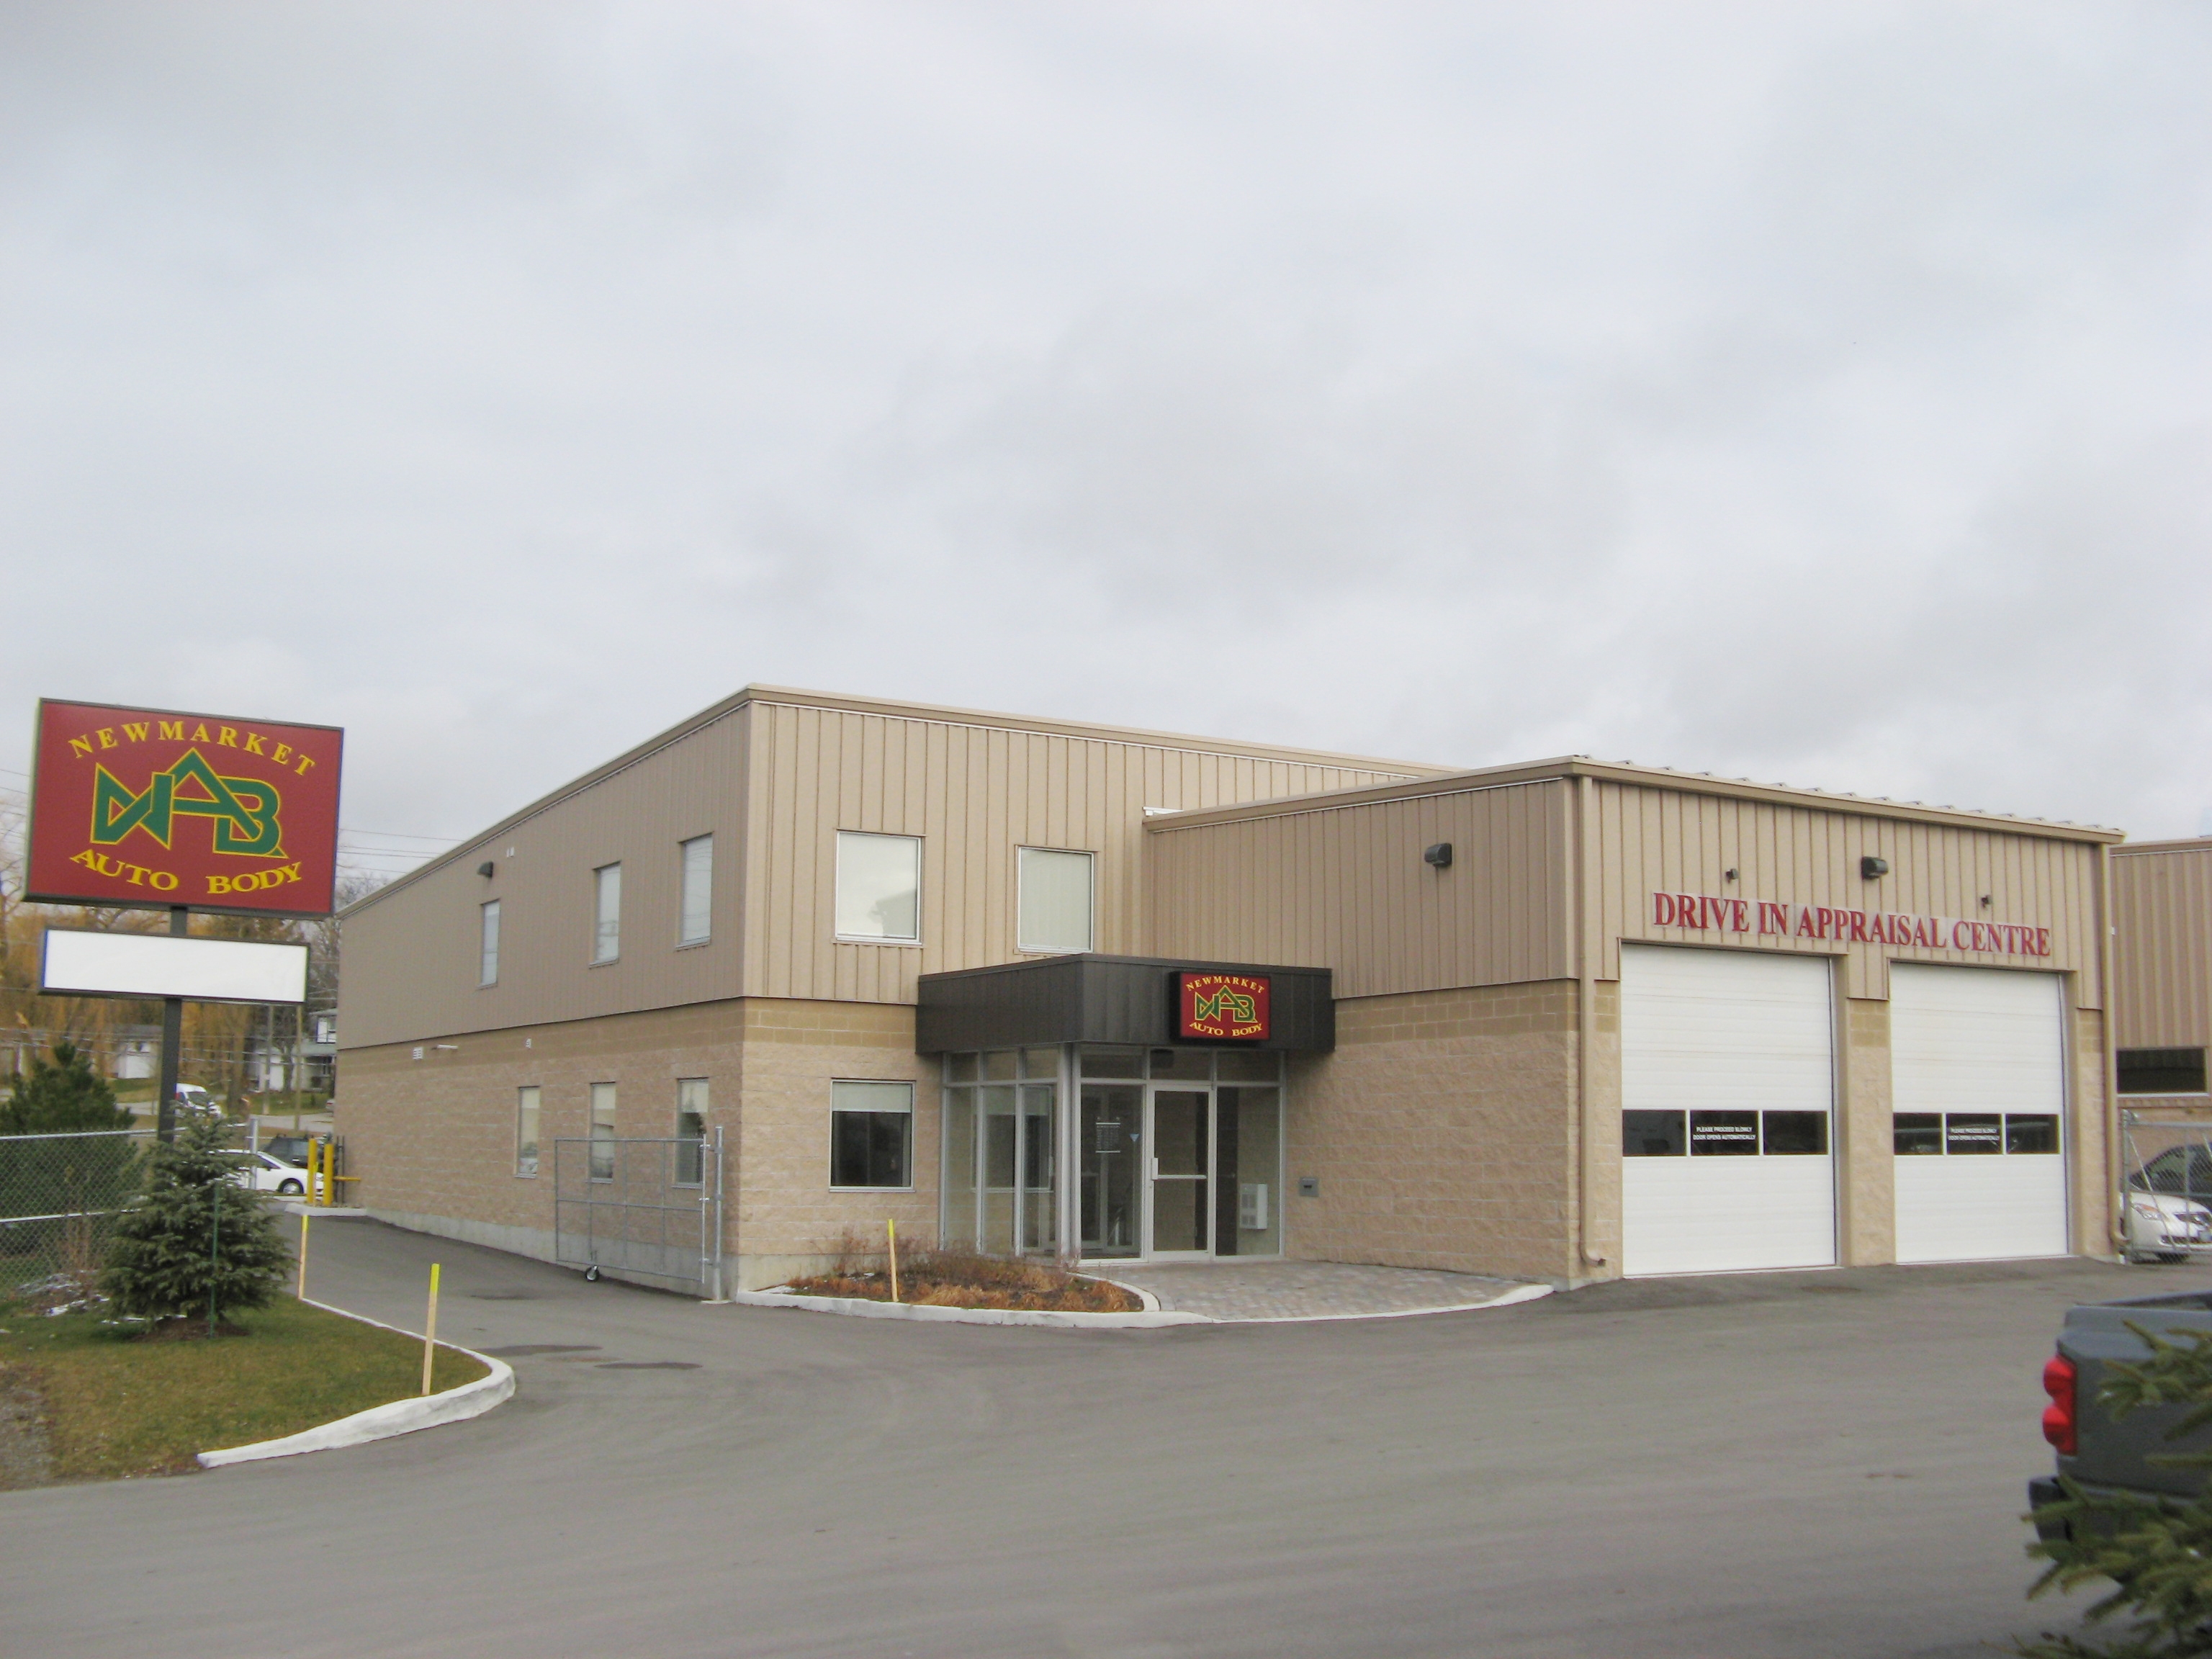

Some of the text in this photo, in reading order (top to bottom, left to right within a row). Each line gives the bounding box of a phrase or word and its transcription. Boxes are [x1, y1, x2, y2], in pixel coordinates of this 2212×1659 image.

[68, 721, 315, 776] NEWMARKET
[70, 848, 302, 894] AUTO BODY
[1654, 892, 2051, 957] DRIVE IN APPRAISAL CENTRE
[1186, 976, 1264, 994] NEWMARKET
[1190, 1022, 1262, 1037] AUTO BODY
